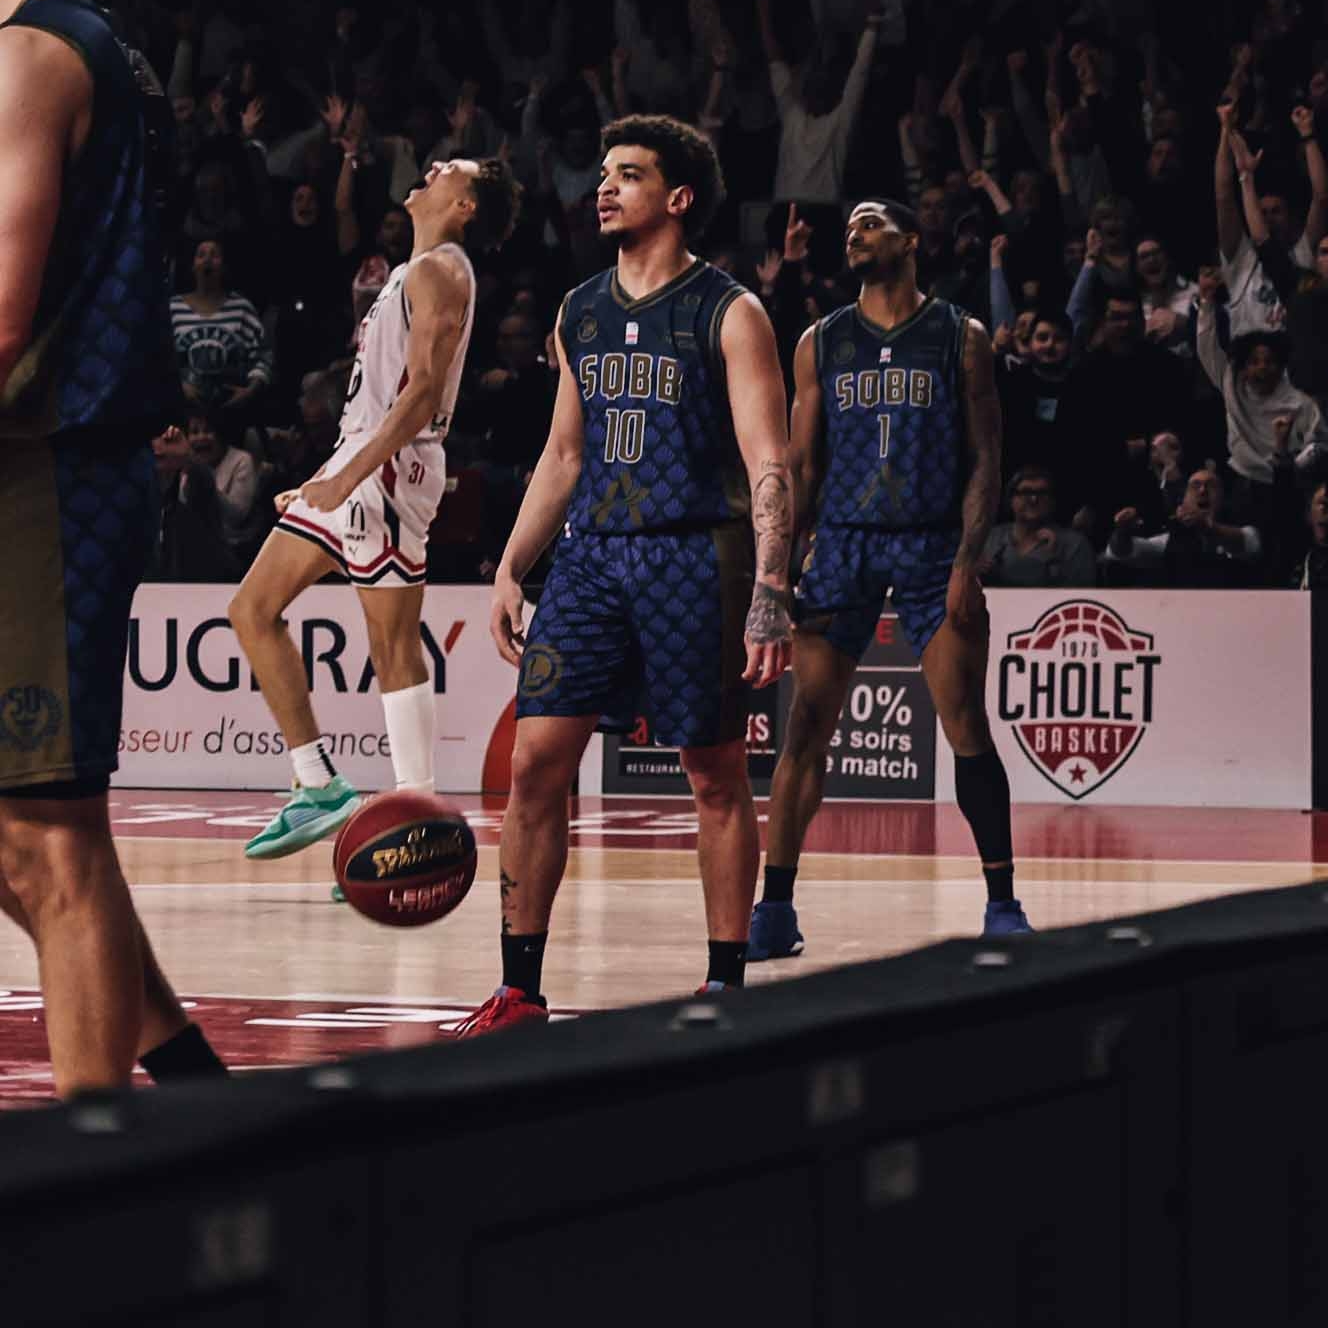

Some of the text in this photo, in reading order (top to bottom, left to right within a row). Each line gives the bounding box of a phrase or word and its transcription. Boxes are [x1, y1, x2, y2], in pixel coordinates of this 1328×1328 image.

[579, 352, 684, 405] SQBB
[835, 368, 932, 412] SQBB
[604, 408, 646, 464] 10
[877, 414, 890, 458] 1
[838, 684, 912, 726] 0%
[998, 654, 1161, 723] CHOLET
[203, 717, 393, 758] d'assance
[849, 728, 912, 752] soirs
[1034, 727, 1123, 753] BASKET
[841, 756, 918, 780] match
